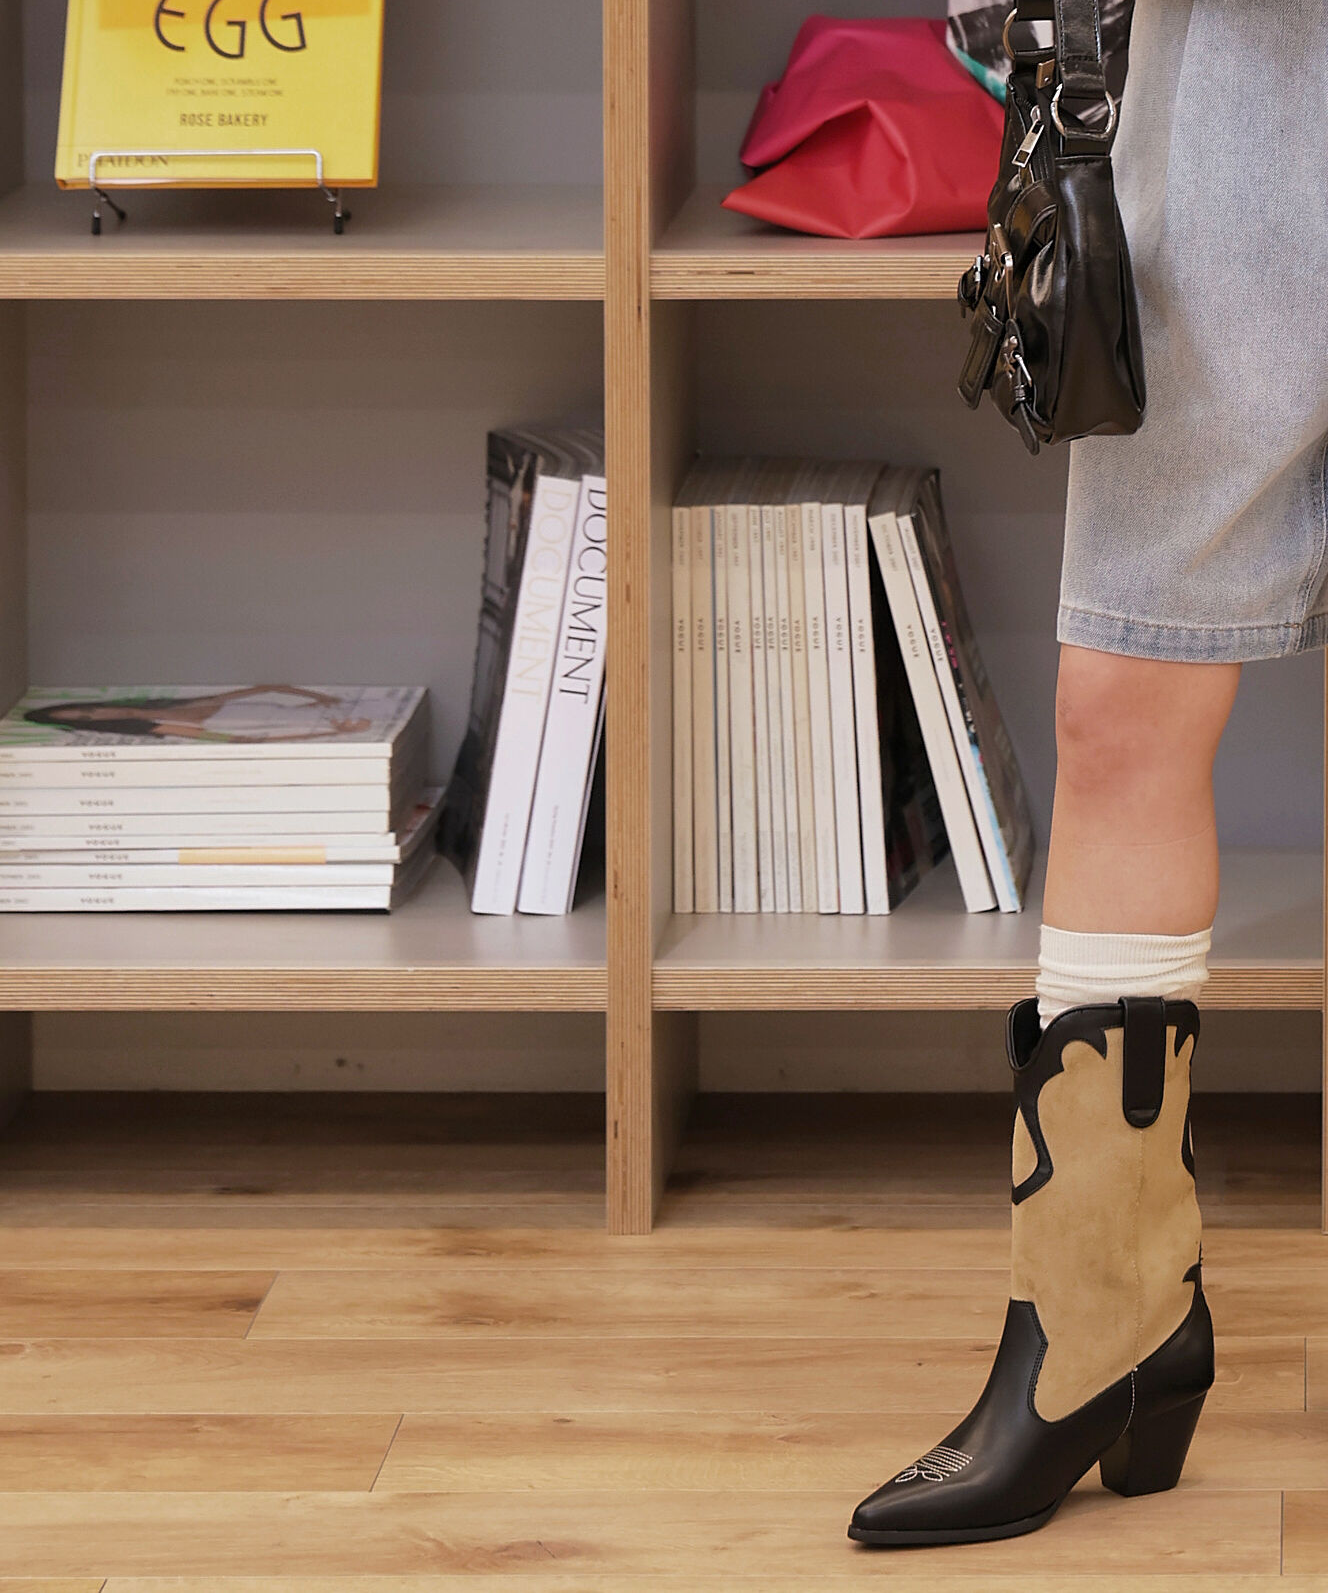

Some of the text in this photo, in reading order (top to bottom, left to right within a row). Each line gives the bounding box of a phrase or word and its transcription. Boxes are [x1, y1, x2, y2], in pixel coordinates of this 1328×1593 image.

[180, 113, 268, 127] ROSE BAKERY
[512, 490, 573, 703] DOCUMENT
[558, 488, 607, 705] DOCUMENT
[794, 619, 802, 652] VOGUE
[812, 616, 820, 649] VOGUE
[835, 617, 843, 651] VOGUE
[858, 619, 866, 653] VOGUE
[906, 624, 920, 658] VOGUE
[930, 627, 944, 662] VOGUE
